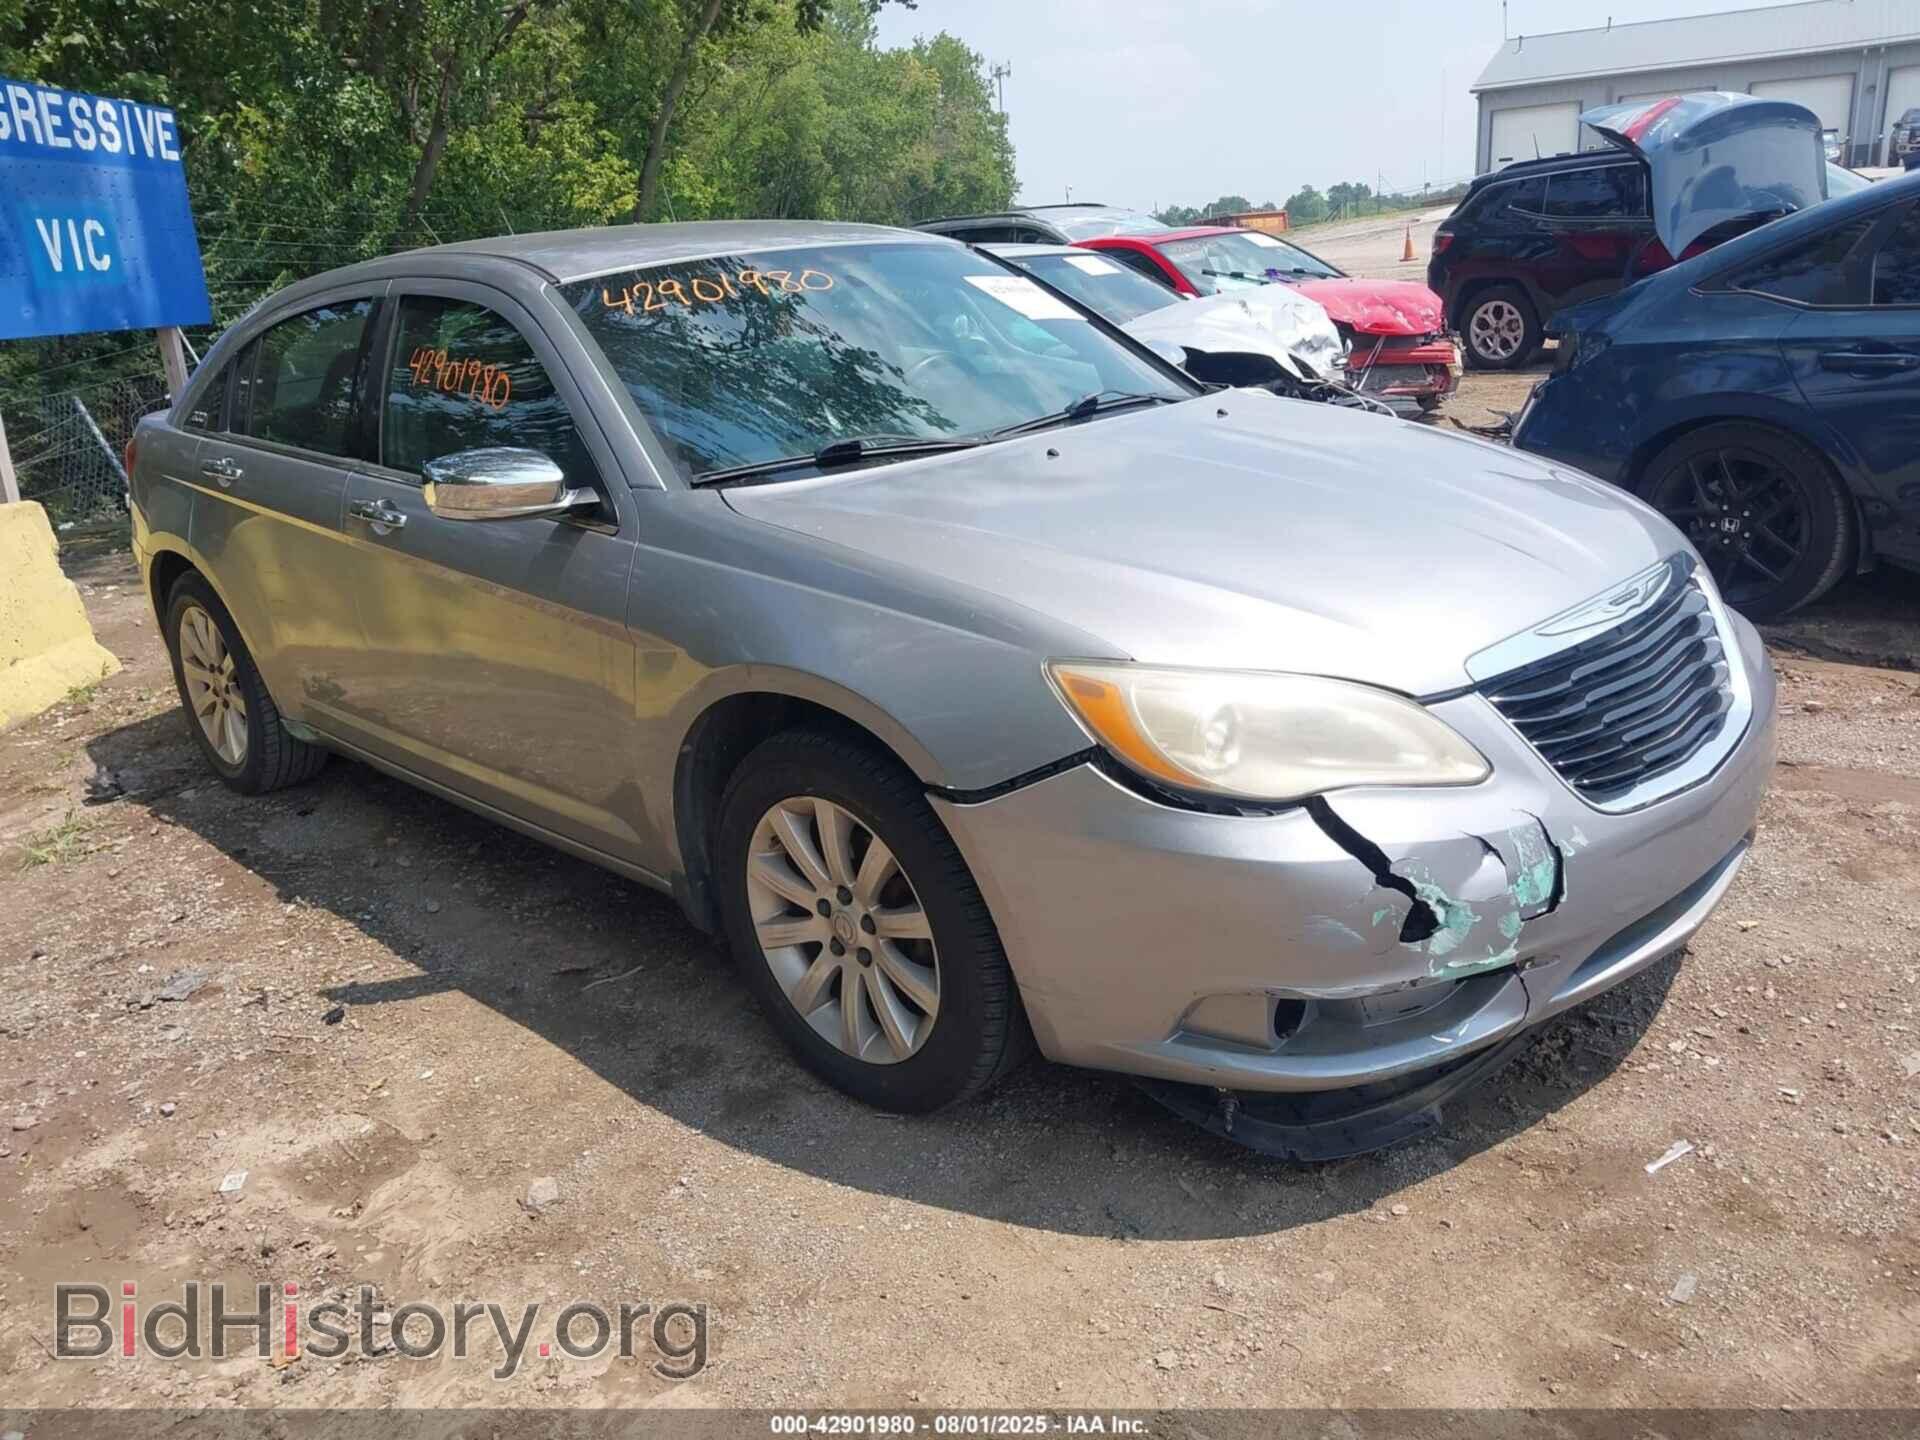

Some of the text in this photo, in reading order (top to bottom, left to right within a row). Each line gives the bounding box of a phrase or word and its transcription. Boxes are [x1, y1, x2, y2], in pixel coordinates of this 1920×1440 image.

[36, 218, 111, 272] VIC
[602, 270, 833, 316] 42901980
[409, 346, 512, 410] 42901980
